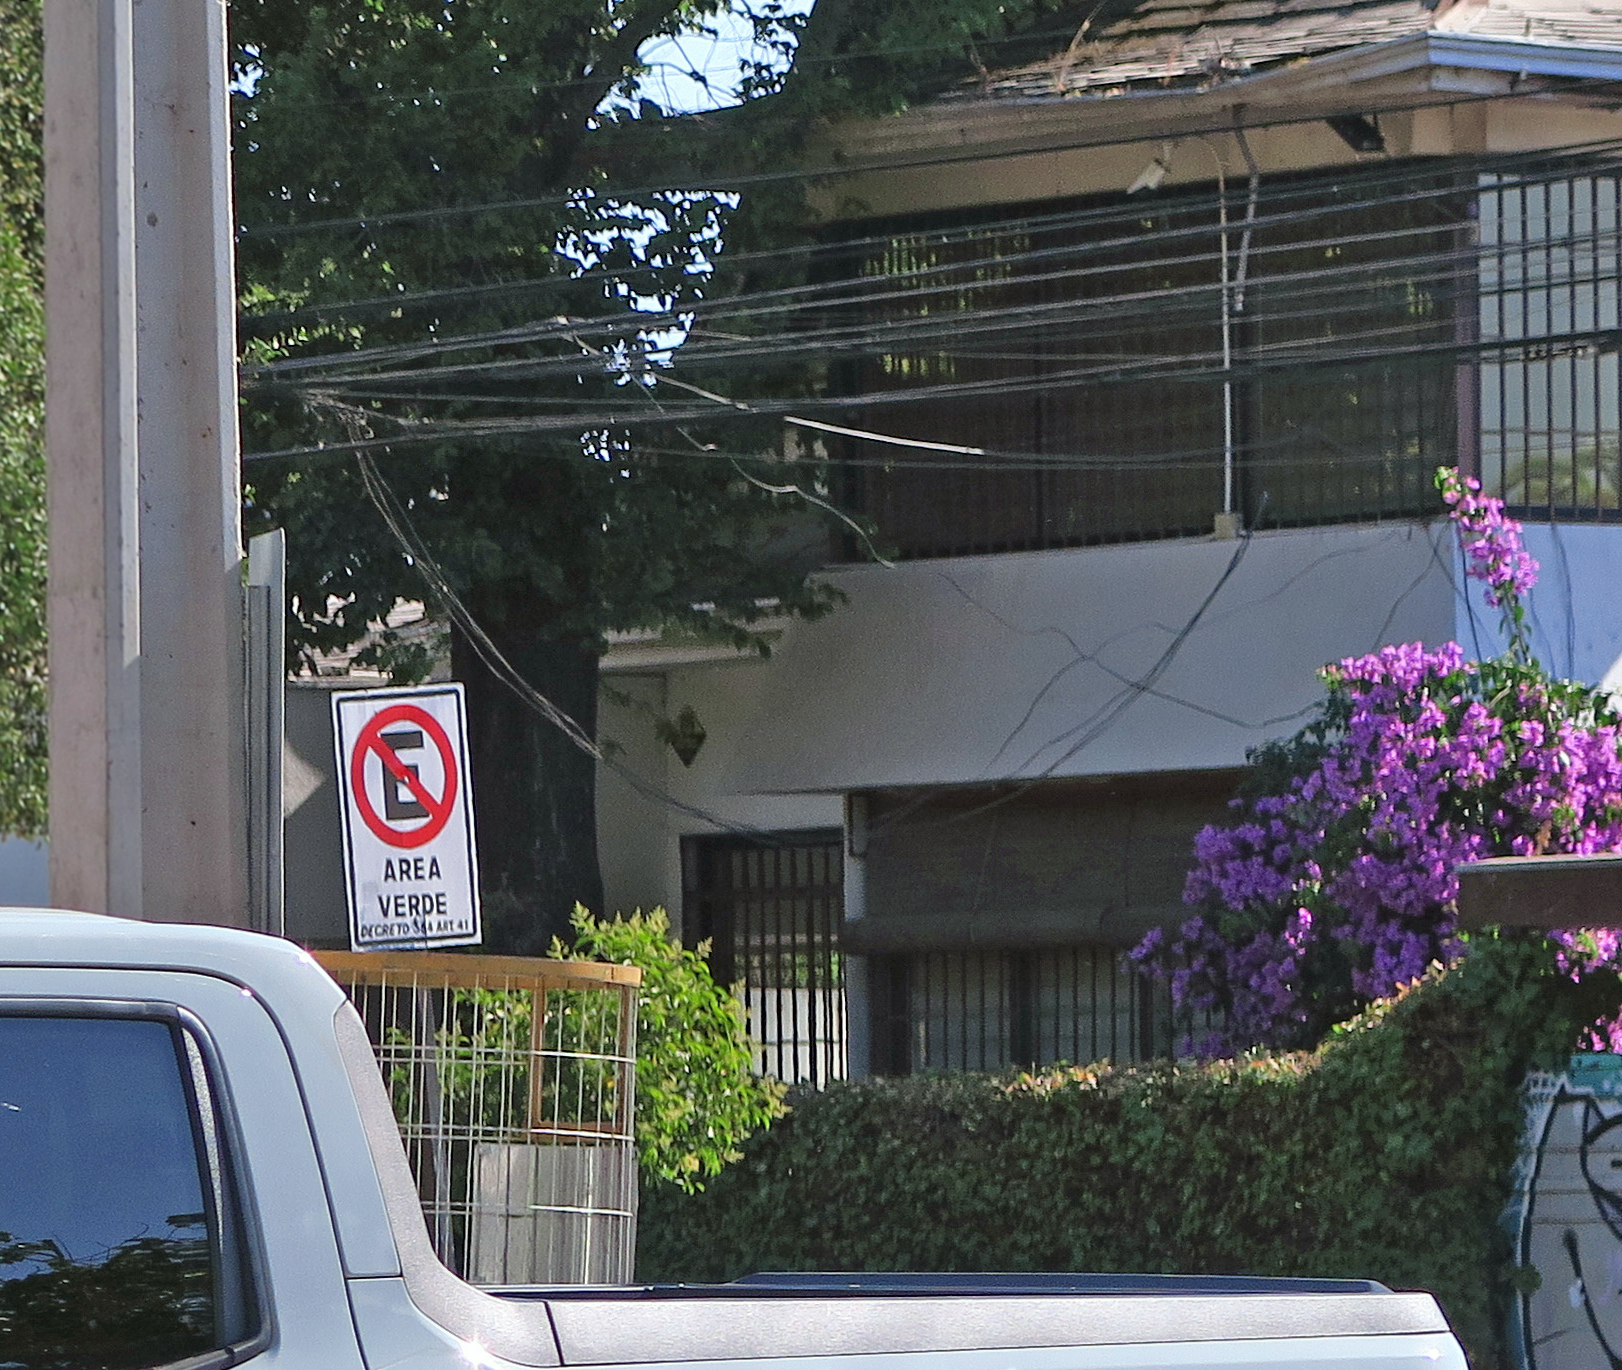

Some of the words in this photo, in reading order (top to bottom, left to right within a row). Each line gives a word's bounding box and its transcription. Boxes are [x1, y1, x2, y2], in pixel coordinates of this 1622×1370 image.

[383, 856, 442, 882] AREA
[377, 892, 447, 918] VERDE
[360, 922, 410, 938] DECRETO
